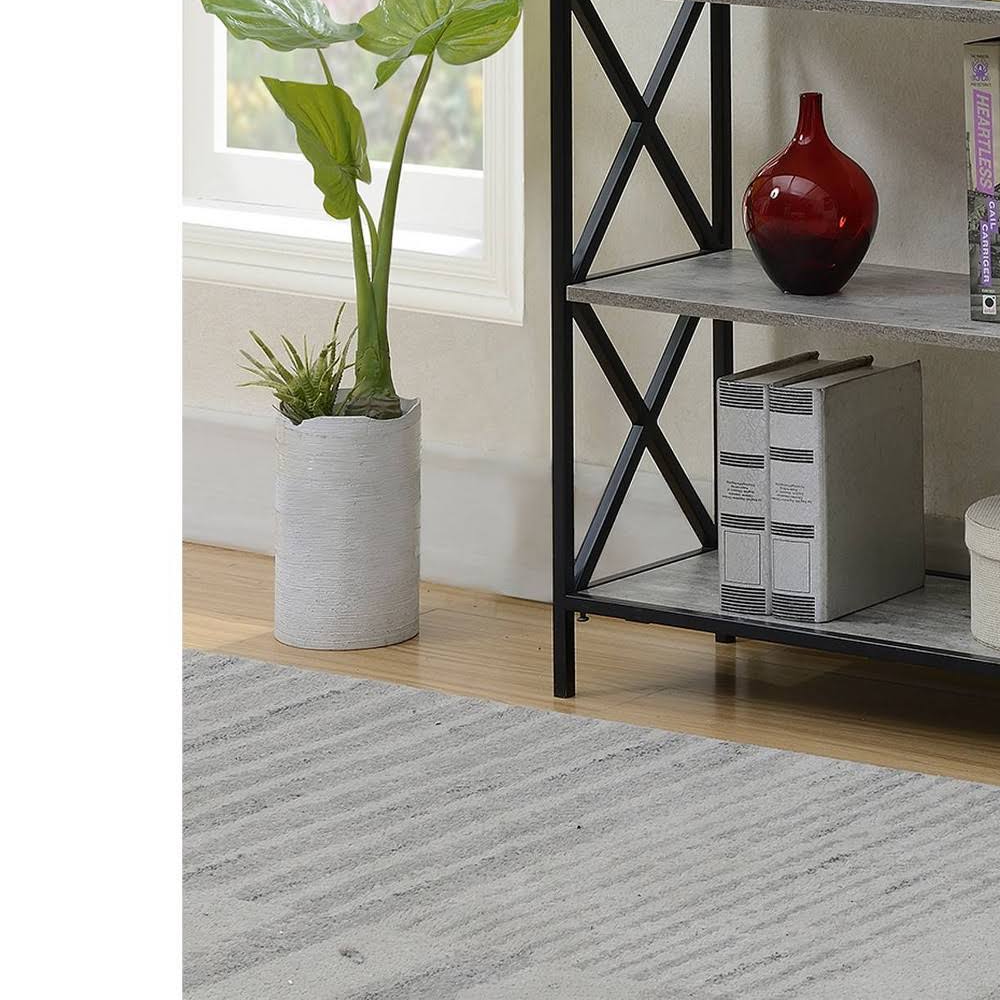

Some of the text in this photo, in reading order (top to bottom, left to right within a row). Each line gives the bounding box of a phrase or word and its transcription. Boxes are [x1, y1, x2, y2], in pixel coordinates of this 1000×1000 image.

[974, 91, 993, 194] HEARTLESS
[988, 201, 997, 230] GAIL
[981, 223, 990, 283] CARRIGER
